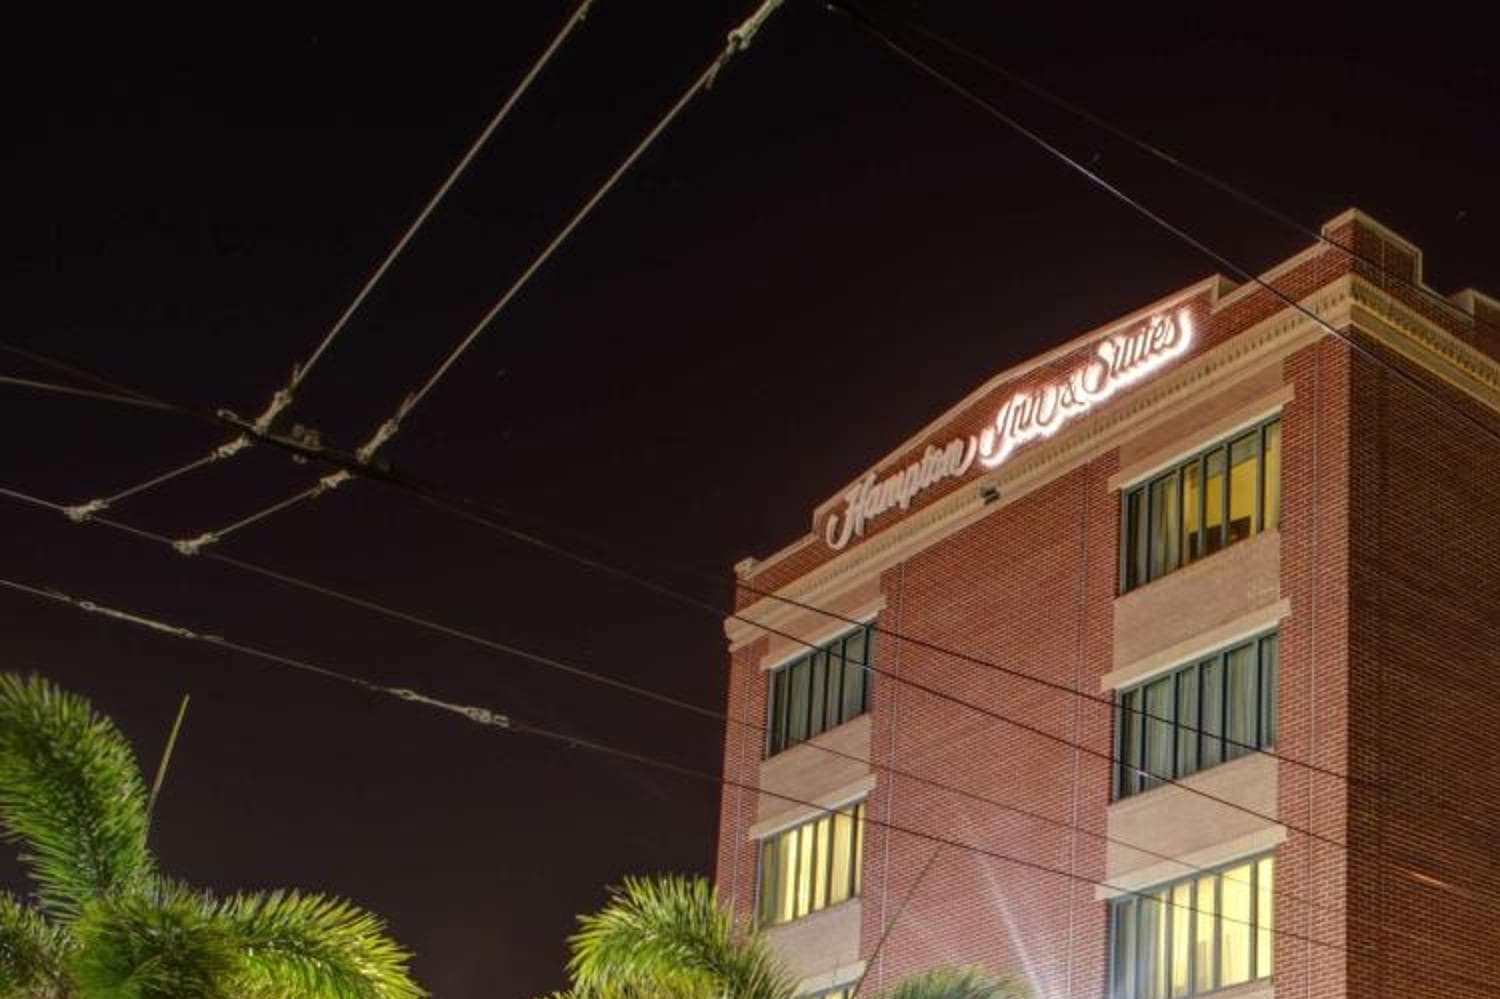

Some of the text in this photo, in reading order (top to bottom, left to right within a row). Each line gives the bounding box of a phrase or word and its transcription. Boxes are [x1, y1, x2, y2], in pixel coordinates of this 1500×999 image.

[827, 435, 978, 550] Hampton
[979, 386, 1061, 466] Inn
[1082, 308, 1194, 396] Suites
